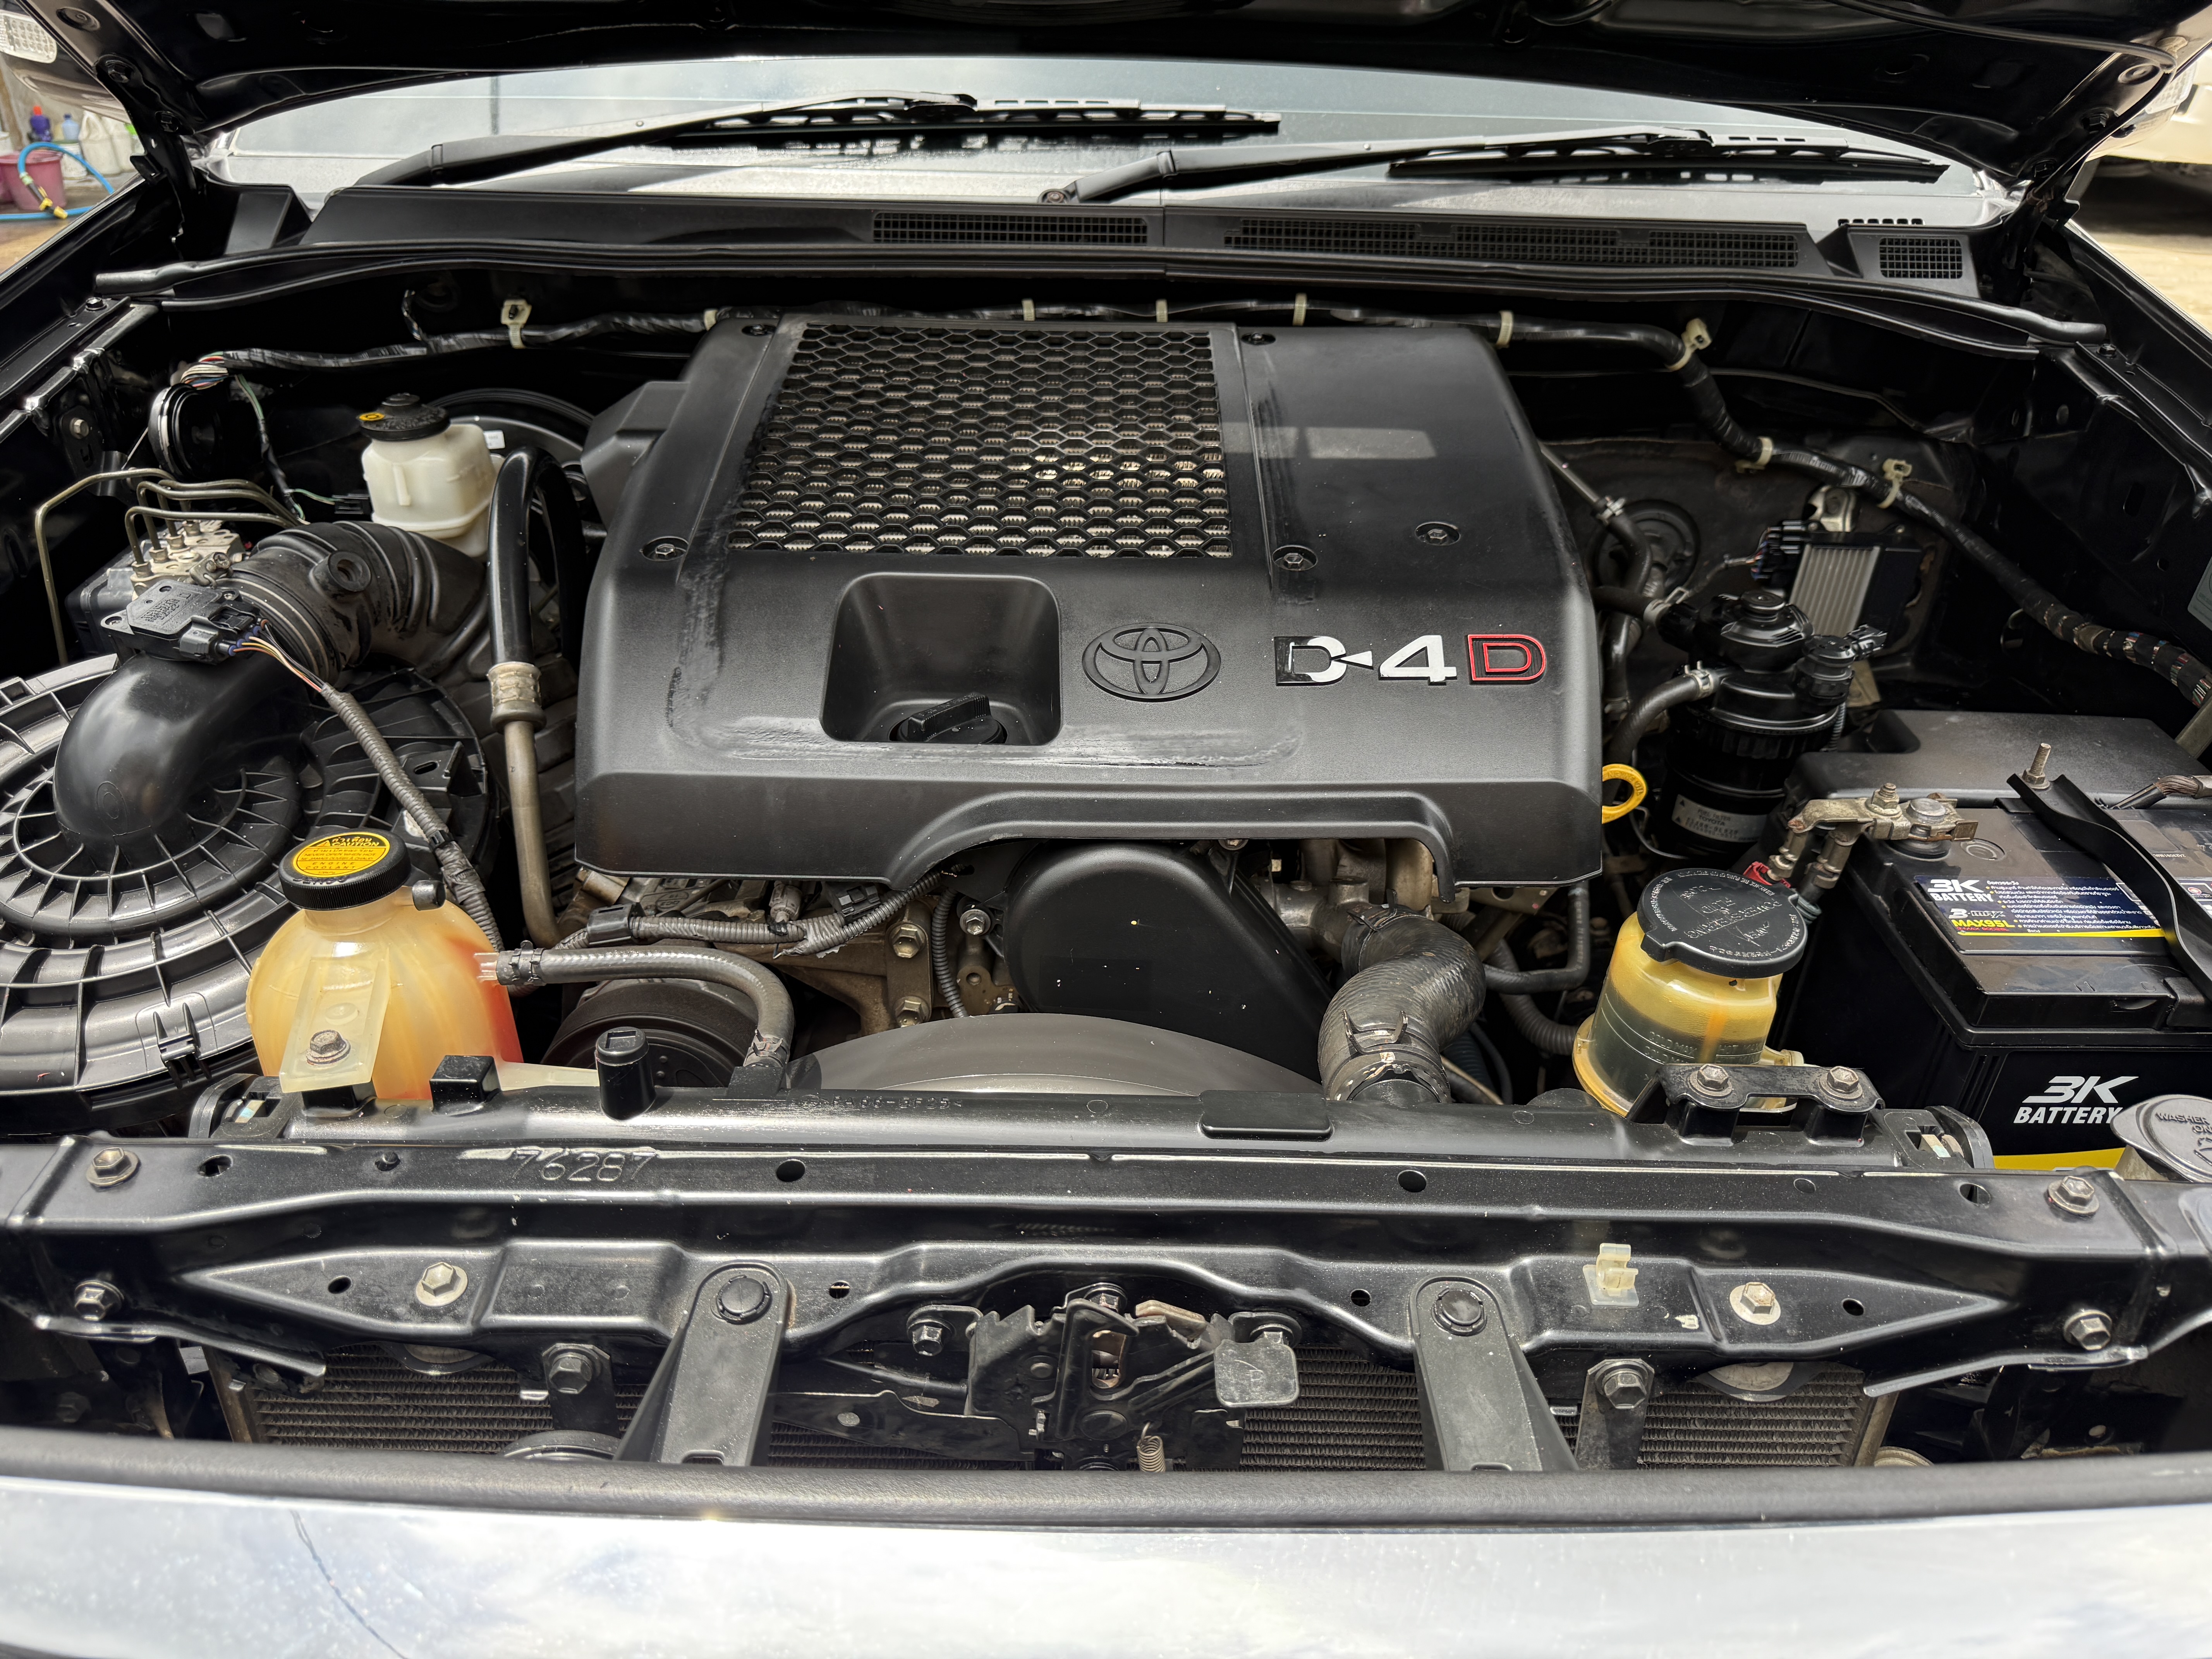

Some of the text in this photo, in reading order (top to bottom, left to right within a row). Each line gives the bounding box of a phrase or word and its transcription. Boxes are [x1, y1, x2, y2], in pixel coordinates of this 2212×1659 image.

[1274, 634, 1546, 685] D-4D
[1699, 815, 1726, 826] TOYOTA
[1927, 879, 1984, 893] 3K
[1700, 897, 1736, 914] FLUID
[1930, 893, 1994, 902] BATTERY
[1951, 919, 2015, 928] MAX95L
[1649, 1031, 1698, 1057] COLD MAX
[1719, 1042, 1762, 1054] HOT MAX
[1645, 1046, 1669, 1064] COLD
[2022, 1076, 2139, 1103] 3K
[2014, 1107, 2123, 1123] BATTERY
[2155, 1112, 2210, 1125] WASHER
[513, 1147, 657, 1181] 76287
